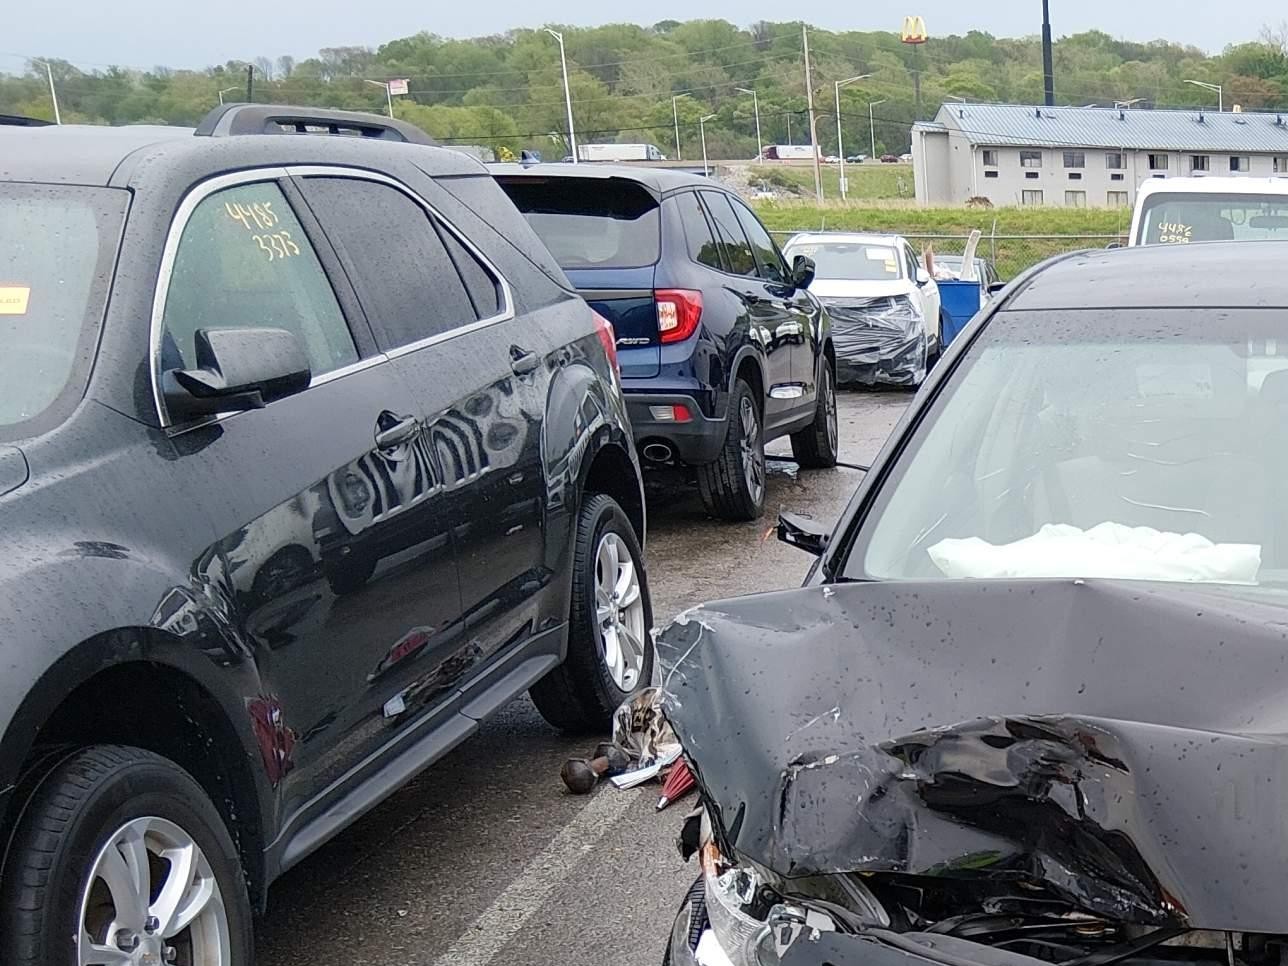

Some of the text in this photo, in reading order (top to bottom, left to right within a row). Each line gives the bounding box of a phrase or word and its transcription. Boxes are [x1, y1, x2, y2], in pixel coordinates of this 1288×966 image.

[224, 201, 279, 229] 4485
[1158, 221, 1193, 237] 4486
[252, 231, 299, 262] 3373
